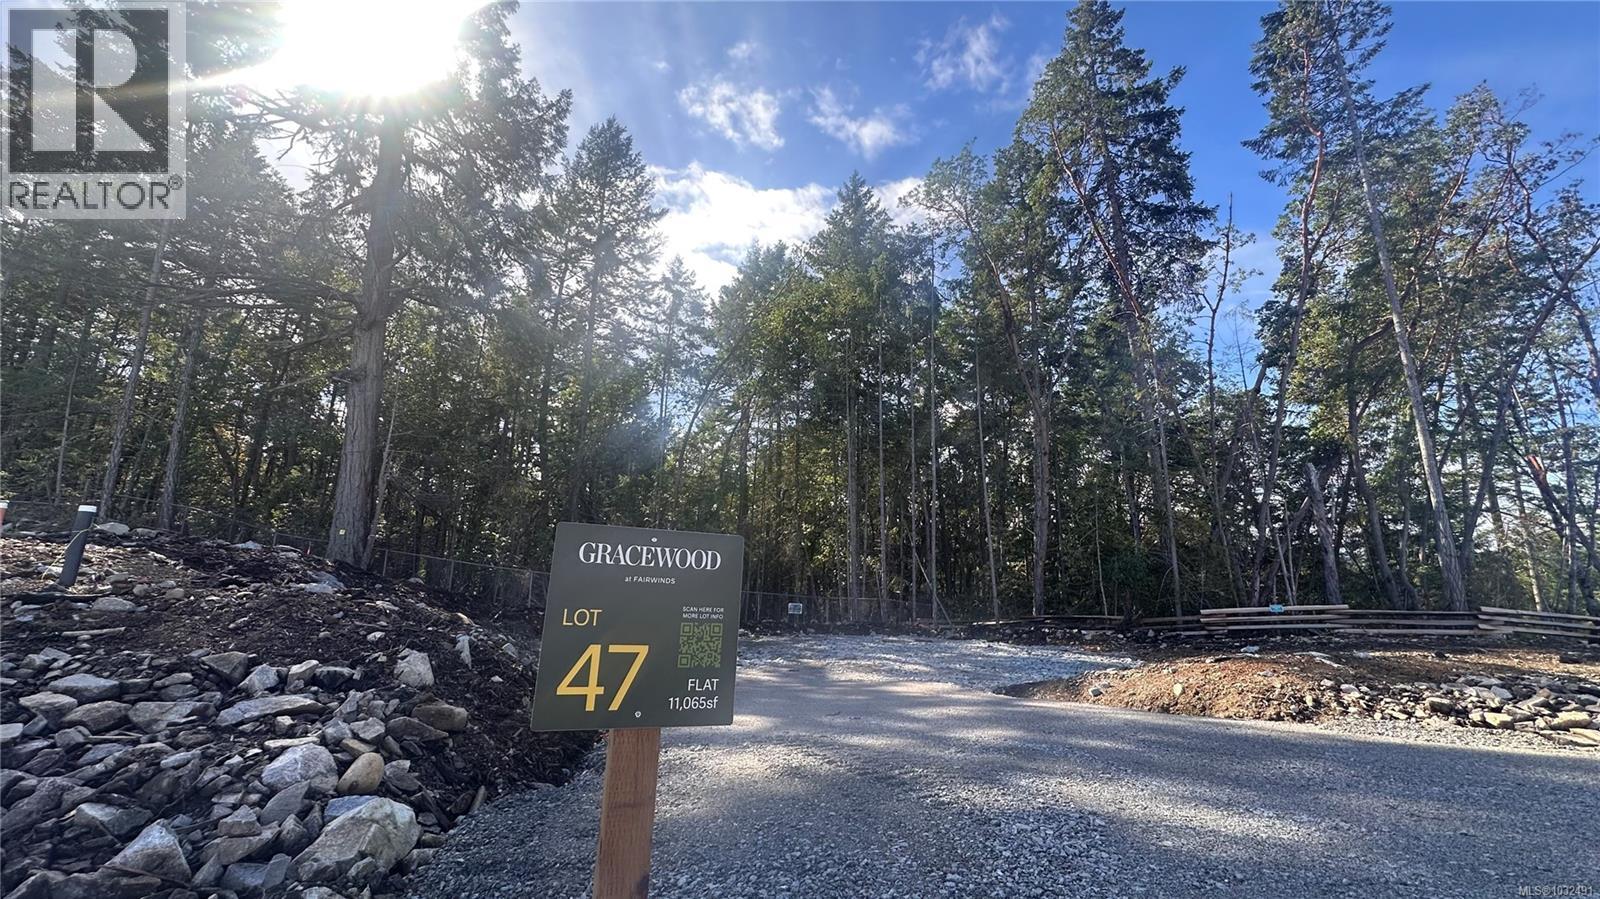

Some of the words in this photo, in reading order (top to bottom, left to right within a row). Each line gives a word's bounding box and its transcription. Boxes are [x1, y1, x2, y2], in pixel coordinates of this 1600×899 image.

[578, 541, 722, 571] GRACEWOOD
[633, 576, 676, 585] FAIRWINDS
[562, 608, 602, 627] LOT
[556, 644, 649, 712] 47
[687, 678, 719, 692] FLAT
[668, 696, 719, 711] 11,065sf
